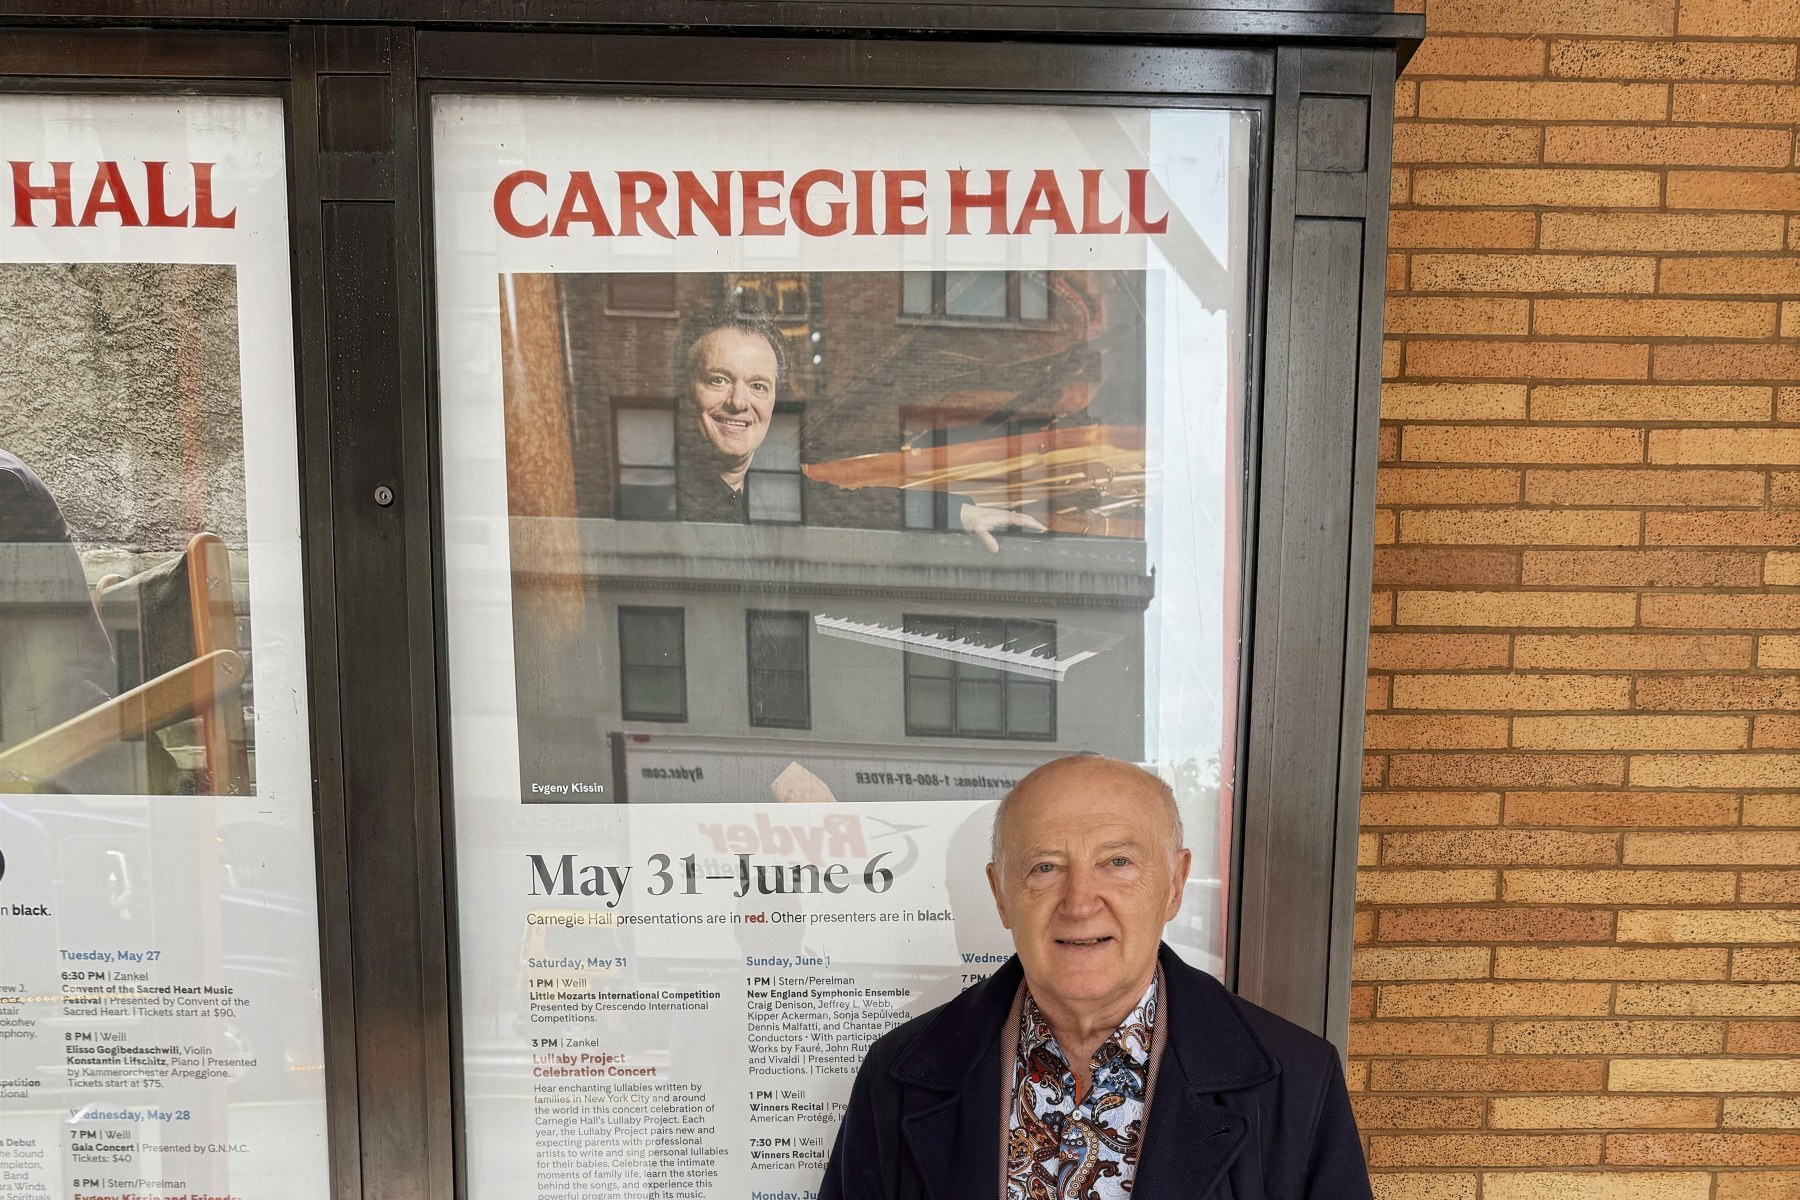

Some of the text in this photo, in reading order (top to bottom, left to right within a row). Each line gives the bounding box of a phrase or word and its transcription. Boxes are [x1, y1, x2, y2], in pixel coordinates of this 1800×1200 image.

[8, 161, 236, 229] HALL
[493, 168, 1169, 239] CARNEGIE HALL
[532, 782, 603, 795] Evgeny Kissin
[525, 851, 893, 908] May 31–June 6
[12, 904, 51, 916] black.
[526, 909, 955, 928] Carnegie Hall presentations are in red. Other presenters are in black.
[59, 949, 160, 963] Tuesday, May 27
[746, 955, 830, 968] Sunday, June 1
[528, 957, 626, 970] Saturday, May 31
[61, 971, 148, 980] 6:30 PM Zankel
[530, 990, 720, 1001] Little Mozarts International Competition
[747, 988, 910, 999] New England Symphonic Ensemble
[530, 1001, 708, 1013] Presented by Crescendo International
[530, 1013, 597, 1024] Competitions.
[747, 1009, 915, 1022] Kipper Ackerman, Sonja Sepúlveda,
[65, 1032, 126, 1041] 8 PM Weill
[531, 1038, 598, 1047] 3 PM Zankel
[66, 1045, 95, 1053] Elisso
[184, 1046, 211, 1054] Violin
[533, 1052, 625, 1066] Lullaby Project
[533, 1066, 656, 1077] Celebration Concert
[750, 1149, 824, 1159] Winners Recital
